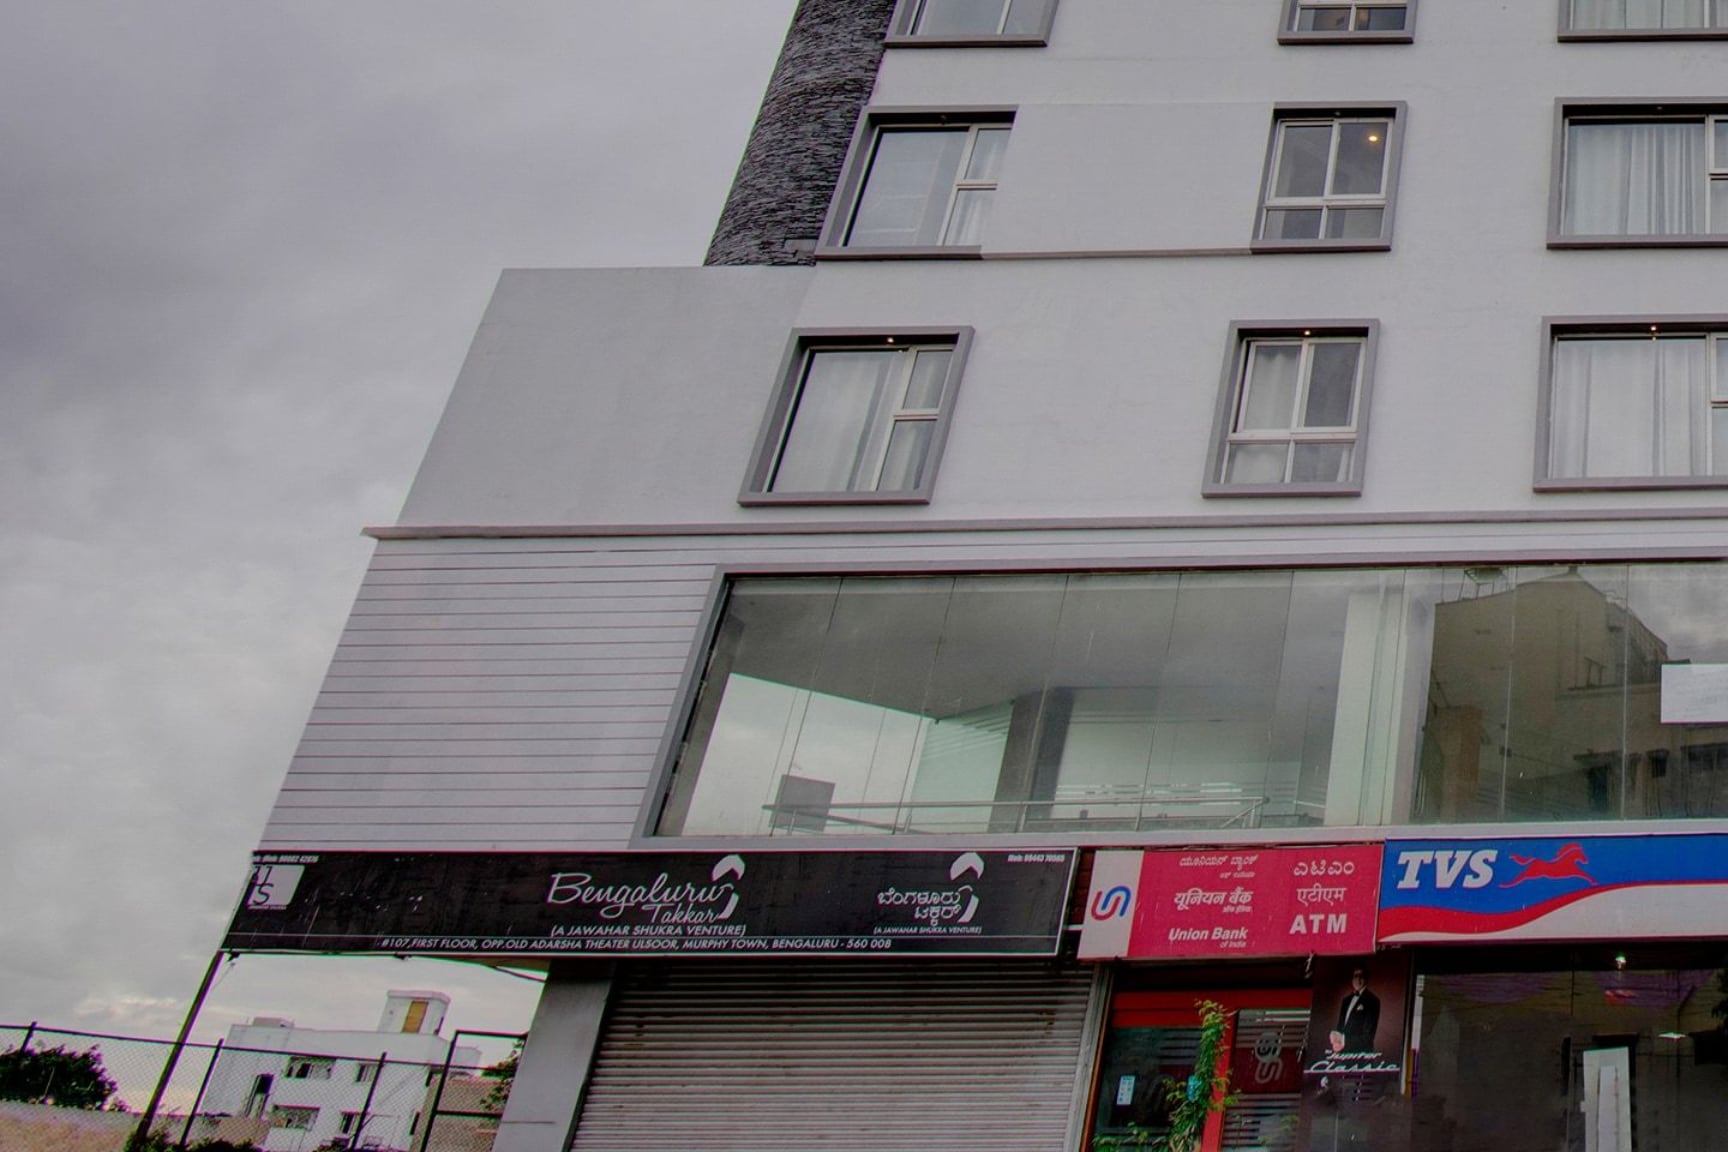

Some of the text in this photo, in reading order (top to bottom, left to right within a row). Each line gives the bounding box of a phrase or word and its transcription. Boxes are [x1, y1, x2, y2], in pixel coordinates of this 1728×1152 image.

[1397, 850, 1498, 889] TVS
[547, 872, 729, 919] Bengaluru
[1174, 887, 1228, 911] यूनियन
[1296, 882, 1348, 907] एटीएम
[641, 902, 719, 924] Takkar
[1289, 913, 1348, 935] ATM
[567, 925, 630, 937] JAWAHAR
[632, 925, 682, 937] SHUKRA
[687, 924, 746, 938] VENTURE)
[1168, 926, 1249, 941] Union Bank
[440, 938, 478, 950] FLOOR,
[528, 939, 582, 949] ADARSHA
[586, 939, 631, 949] THEATER
[632, 939, 679, 951] ULSOOR,
[682, 939, 729, 949] MURPHY
[731, 939, 769, 950] TOWN,
[772, 939, 839, 949] BENGALURU
[846, 939, 868, 949] 560
